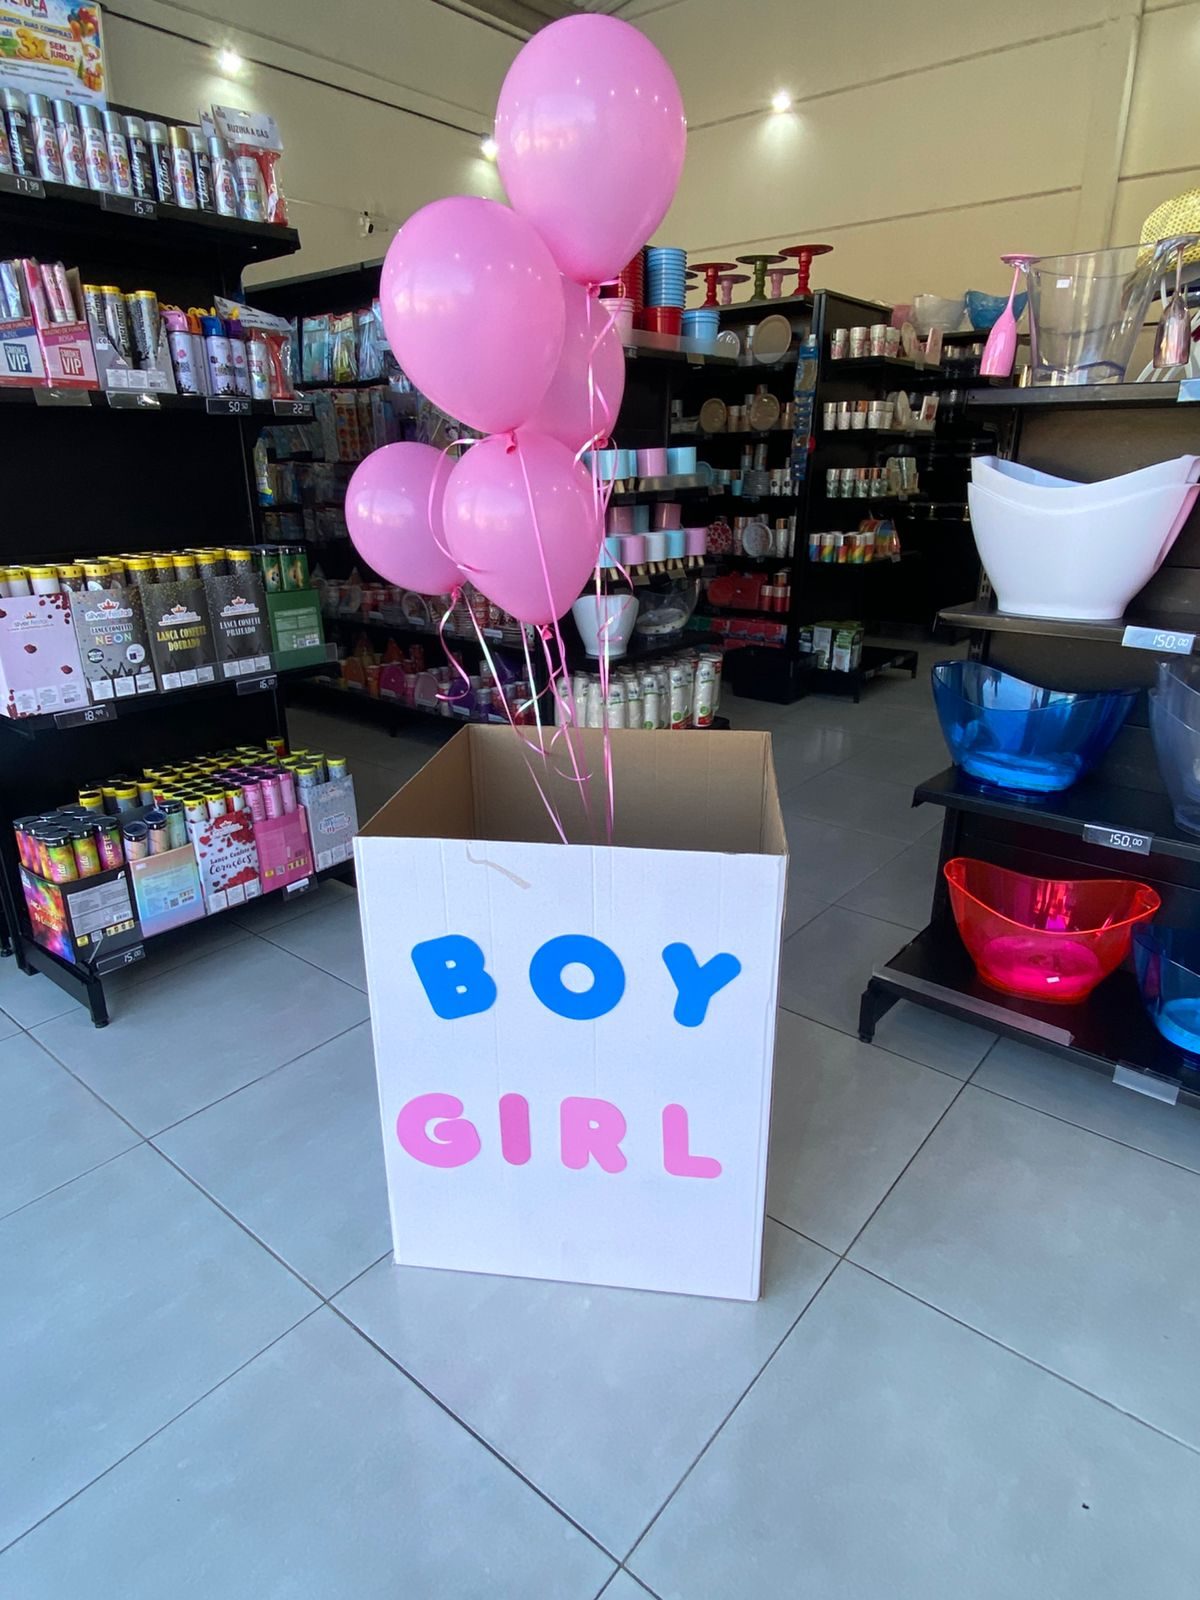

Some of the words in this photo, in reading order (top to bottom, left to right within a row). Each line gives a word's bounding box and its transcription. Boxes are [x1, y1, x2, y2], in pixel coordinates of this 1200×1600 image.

[40, 24, 72, 39] COMPRAS
[49, 41, 67, 51] SEM
[50, 50, 75, 62] JUROS
[8, 353, 29, 371] VIP
[62, 357, 82, 374] VIP
[95, 632, 132, 646] NEON
[156, 629, 179, 642] LANÇA
[1152, 634, 1190, 650] 150.00
[1109, 832, 1143, 849] 150.00
[410, 933, 742, 1028] BOY
[396, 1092, 723, 1180] GIRL
